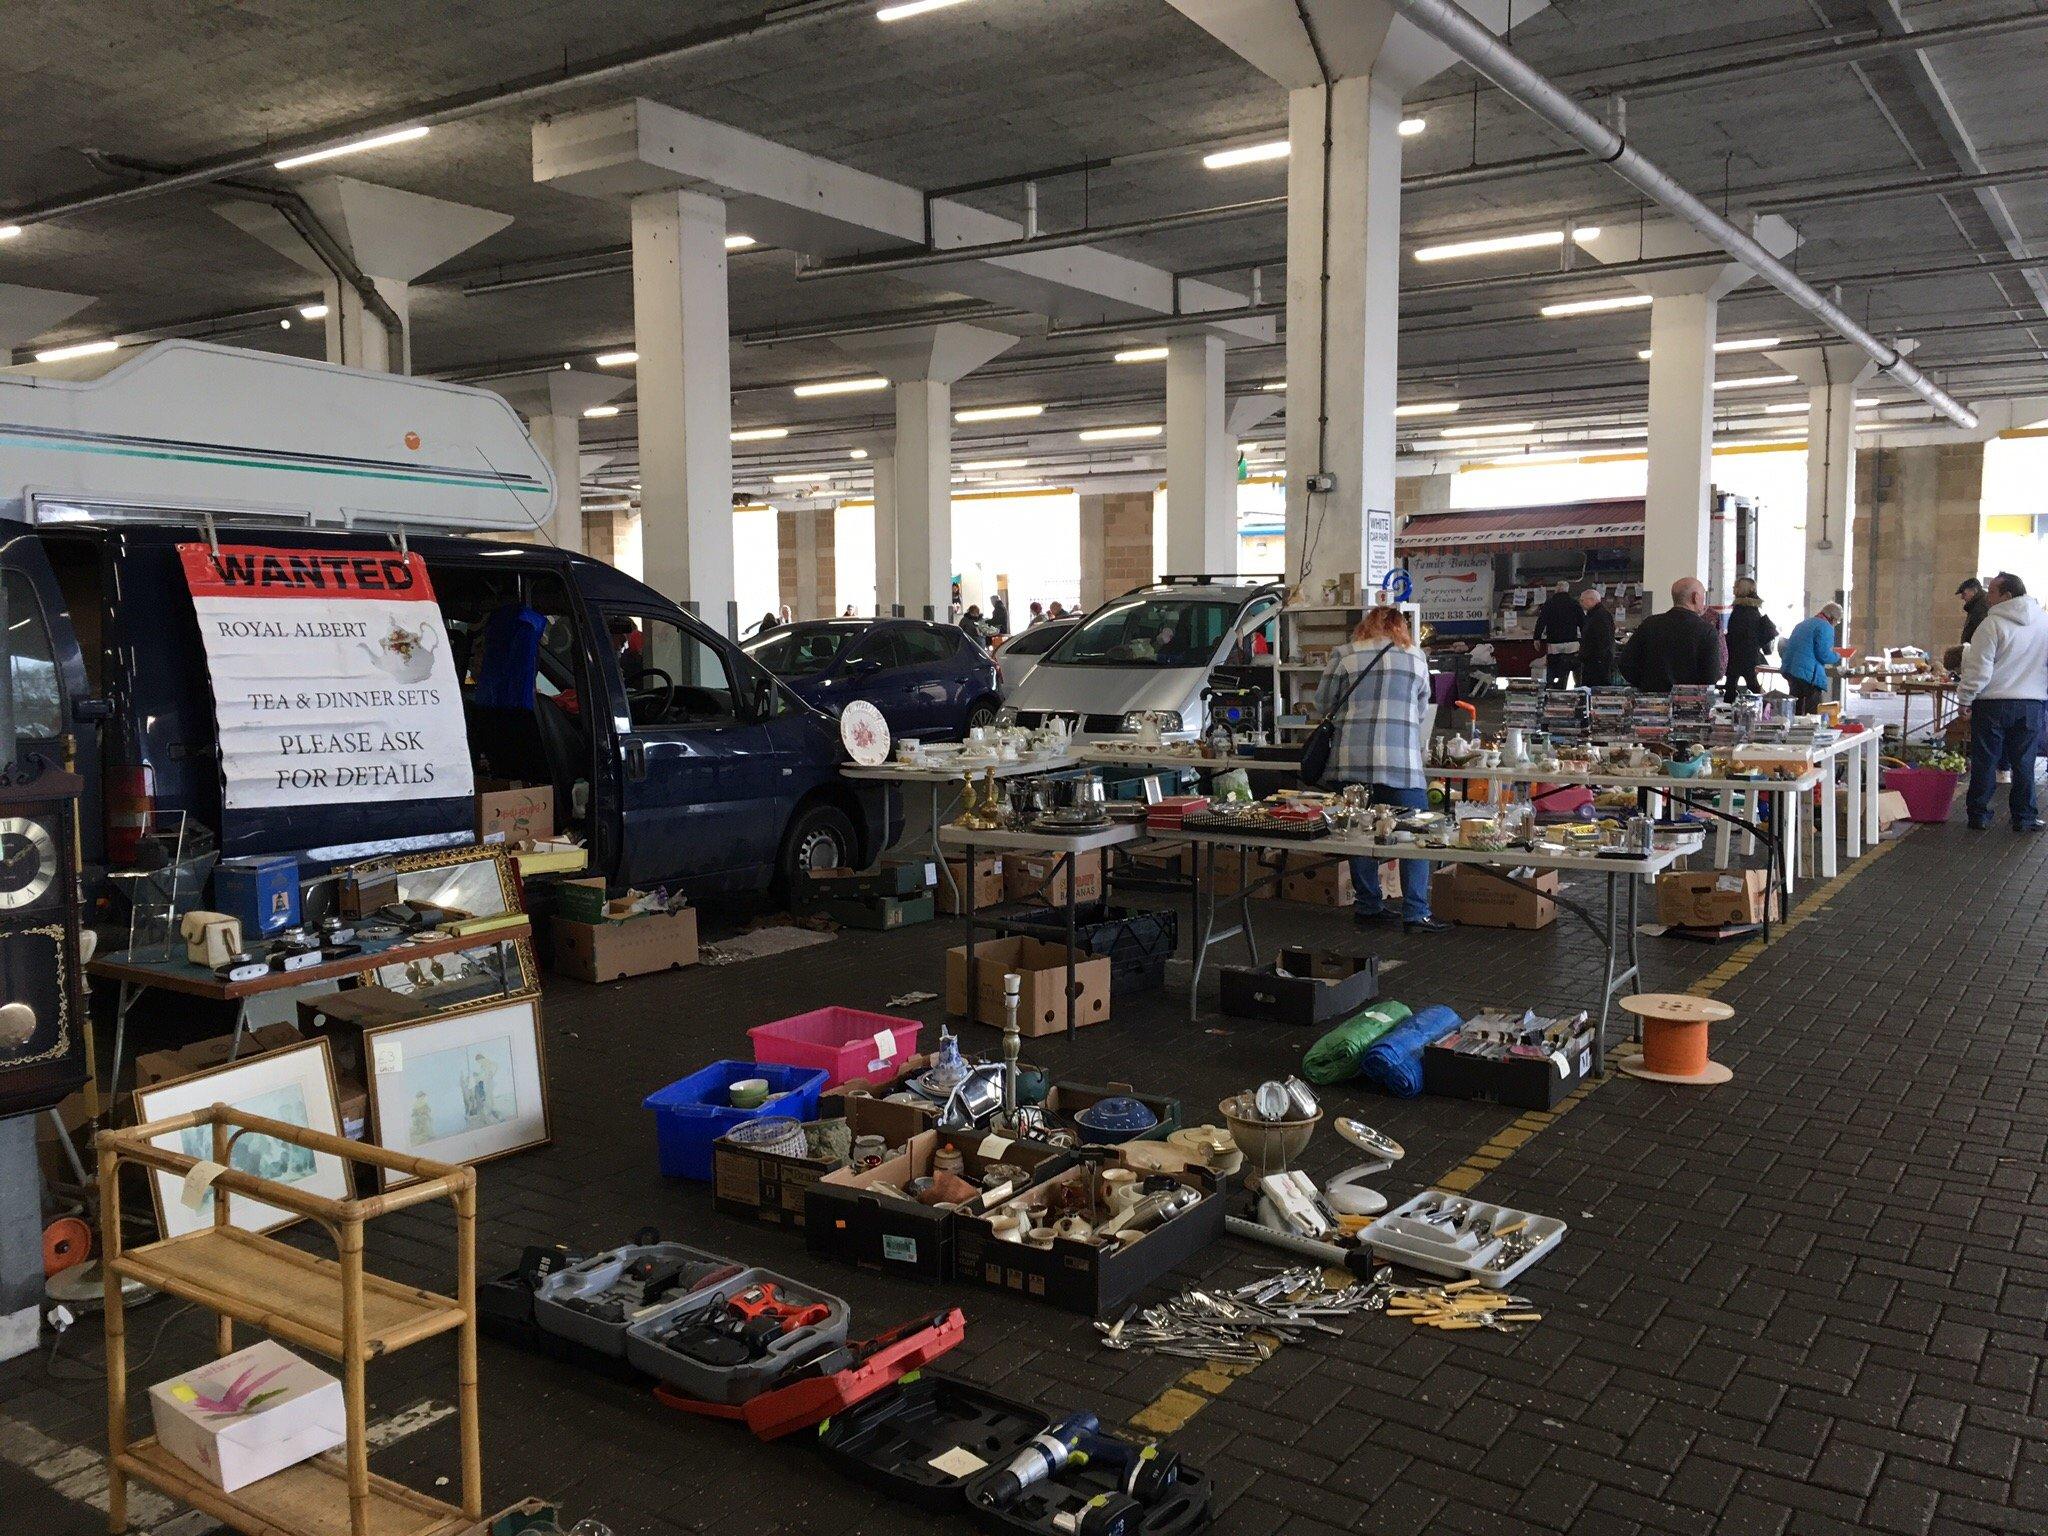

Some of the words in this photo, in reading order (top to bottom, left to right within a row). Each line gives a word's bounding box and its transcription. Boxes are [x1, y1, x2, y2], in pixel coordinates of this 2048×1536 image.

[1370, 518, 1389, 530] WHITE
[1394, 535, 1468, 546] Purveyors
[1475, 532, 1493, 541] of
[1499, 529, 1526, 538] the
[1532, 527, 1586, 537] Finest
[210, 553, 414, 590] WANTED
[217, 621, 289, 638] ROYAL
[293, 622, 367, 638] ALBERT
[248, 693, 290, 711] TEA
[296, 693, 311, 709] &
[315, 691, 394, 709] DINNER
[397, 689, 440, 706] SETS
[279, 732, 373, 756] PLEASE
[380, 731, 424, 751] ASK
[274, 768, 328, 789] FOR
[335, 763, 435, 787] DETAILS
